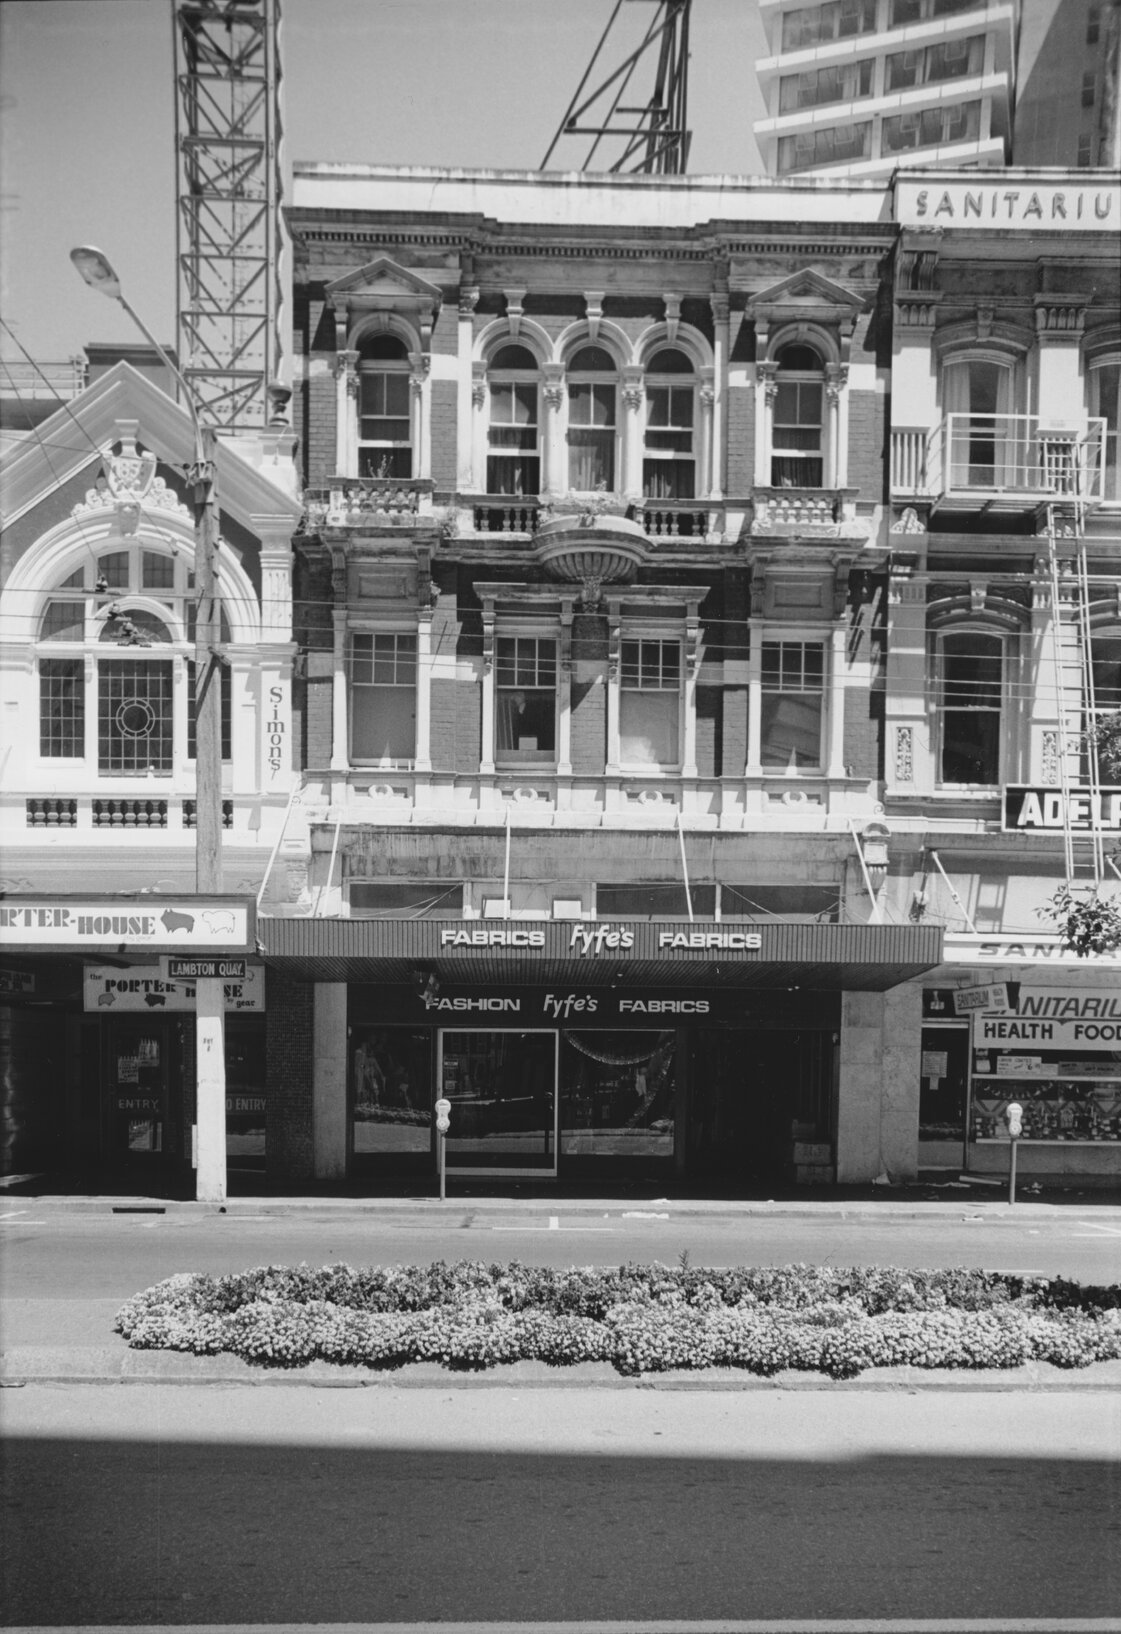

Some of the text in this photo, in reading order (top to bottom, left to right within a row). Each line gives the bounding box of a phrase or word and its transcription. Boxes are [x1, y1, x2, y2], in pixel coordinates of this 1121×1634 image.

[916, 190, 1112, 219] SANITARIU
[266, 686, 285, 772] Simon's
[441, 925, 762, 954] FABRICS Fyfe's FABRICS
[171, 963, 215, 976] LAMBTON
[236, 1000, 255, 1008] gear
[425, 994, 710, 1018] FASHION Fyfe's FABRICS
[984, 1022, 1053, 1040] HEALTH
[118, 1098, 159, 1109] ENTRY
[235, 1098, 267, 1110] ENTRY
